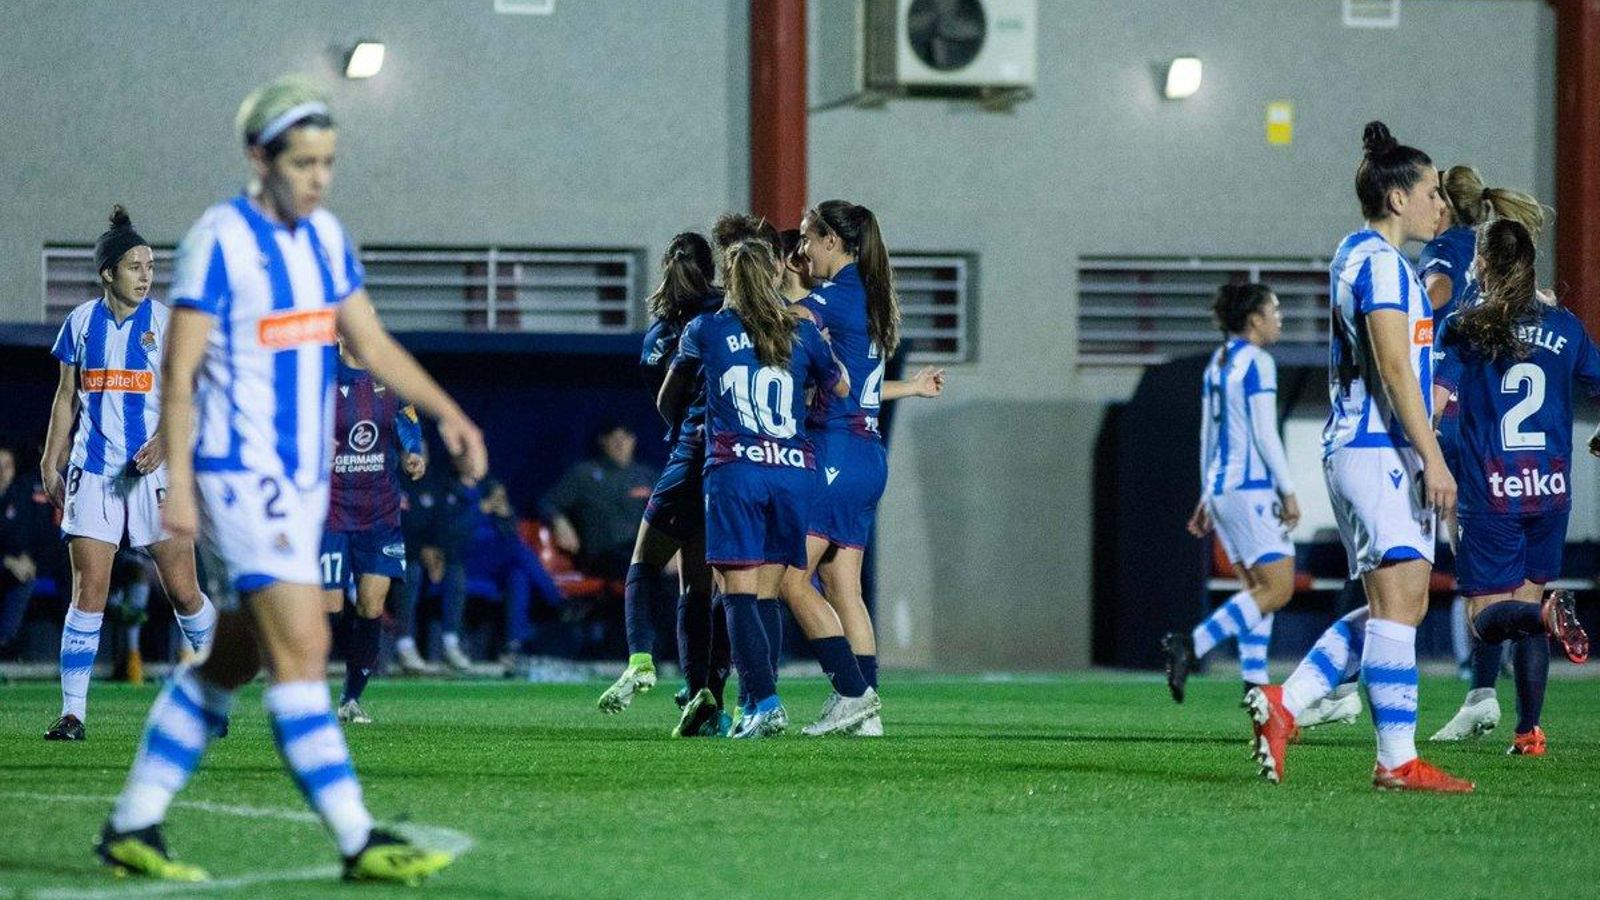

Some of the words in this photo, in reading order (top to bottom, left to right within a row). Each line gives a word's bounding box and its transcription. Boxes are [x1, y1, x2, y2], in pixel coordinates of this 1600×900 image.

[726, 332, 754, 353] BA
[719, 365, 797, 440] 10
[1501, 362, 1546, 451] 2
[335, 453, 385, 465] GERMAINE
[732, 441, 806, 468] teika
[258, 475, 287, 520] 2
[1489, 468, 1567, 498] teika
[319, 552, 343, 584] 17
